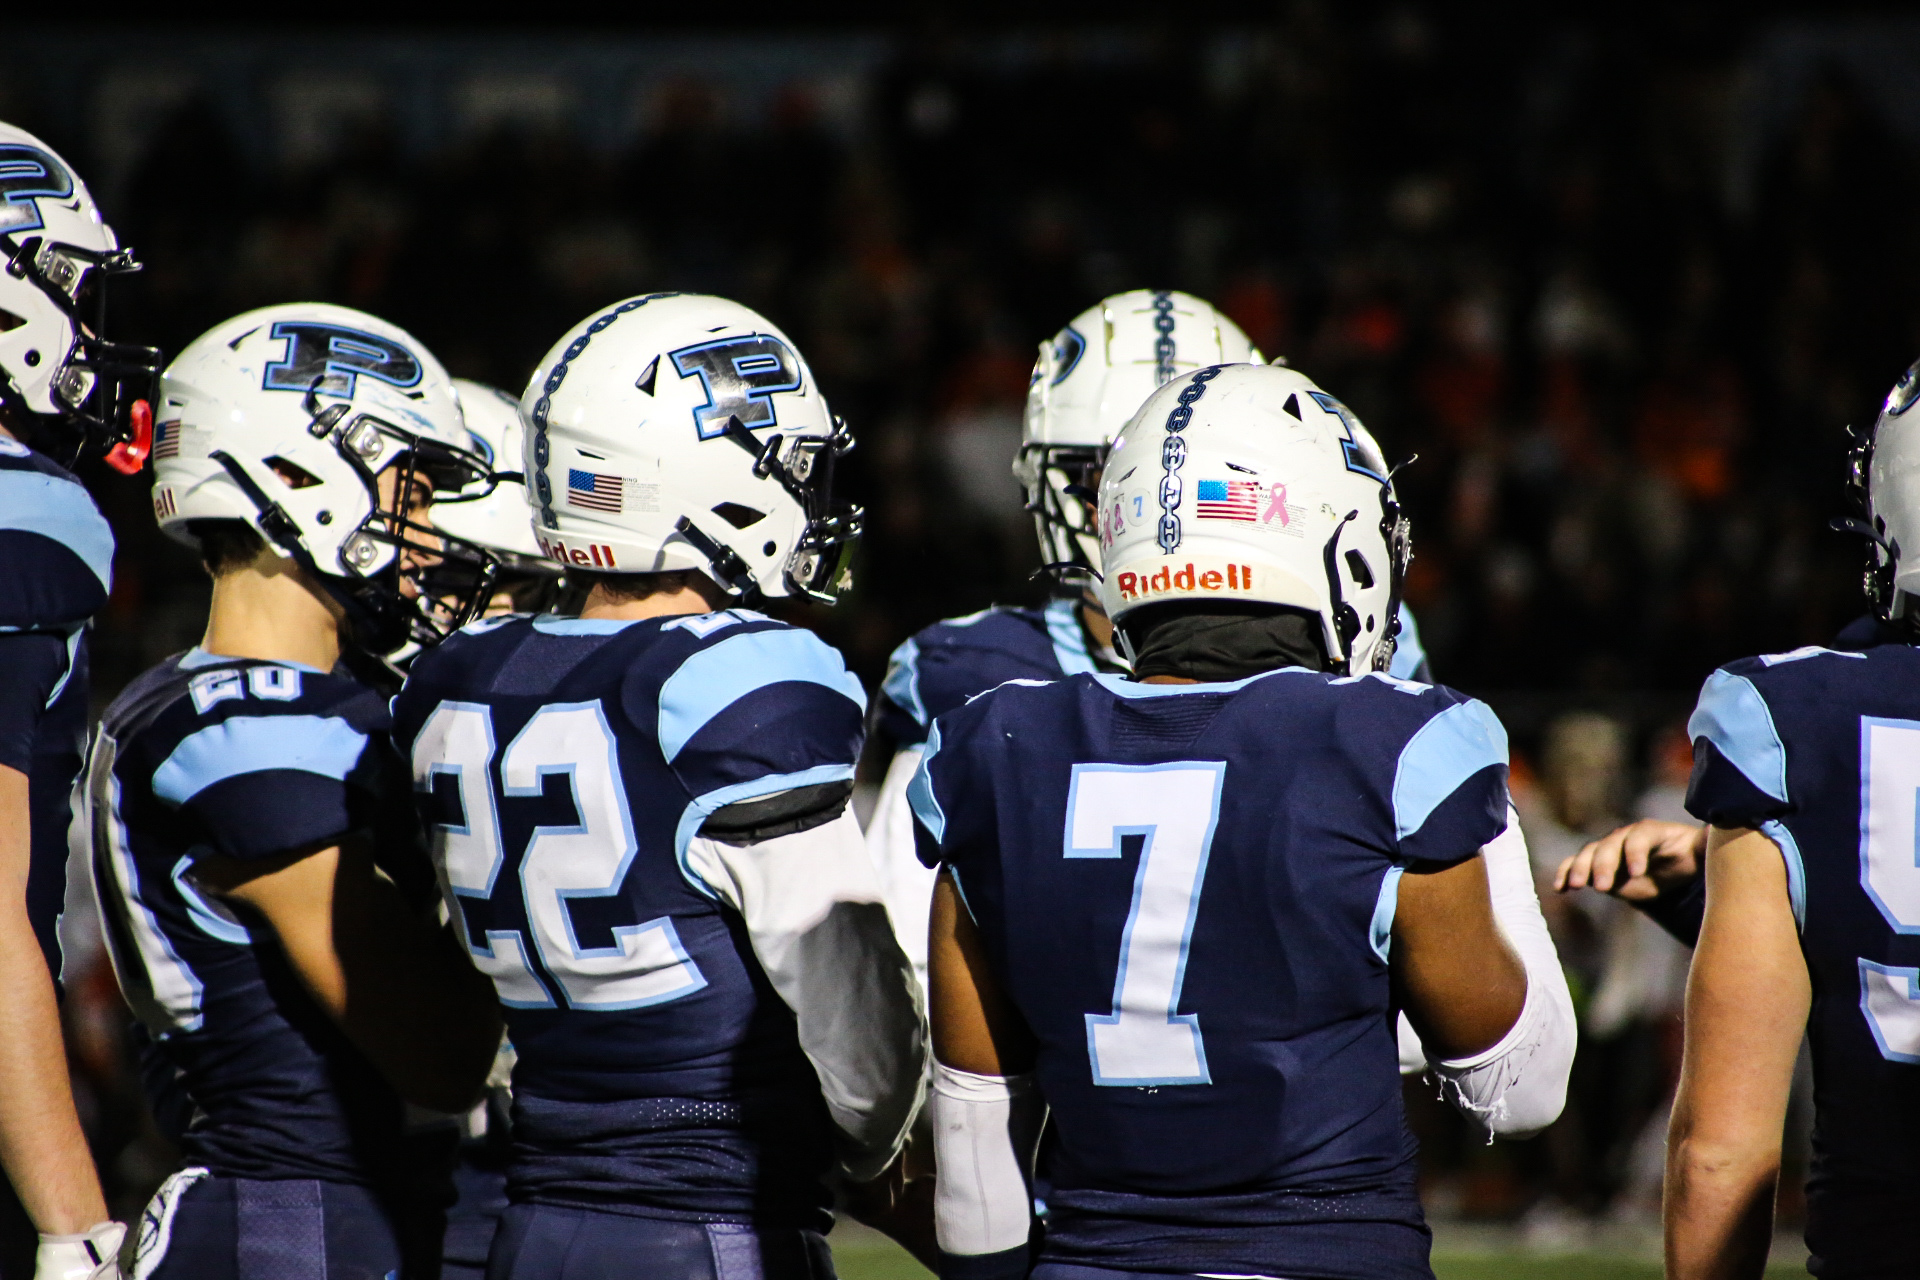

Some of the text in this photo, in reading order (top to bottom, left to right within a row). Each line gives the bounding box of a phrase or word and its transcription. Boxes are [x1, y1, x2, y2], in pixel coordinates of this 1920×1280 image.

[262, 321, 423, 399] P
[667, 333, 804, 441] P
[1133, 496, 1142, 517] 7
[1118, 563, 1252, 600] Riddell
[411, 698, 708, 1011] 22
[1063, 760, 1226, 1086] 7
